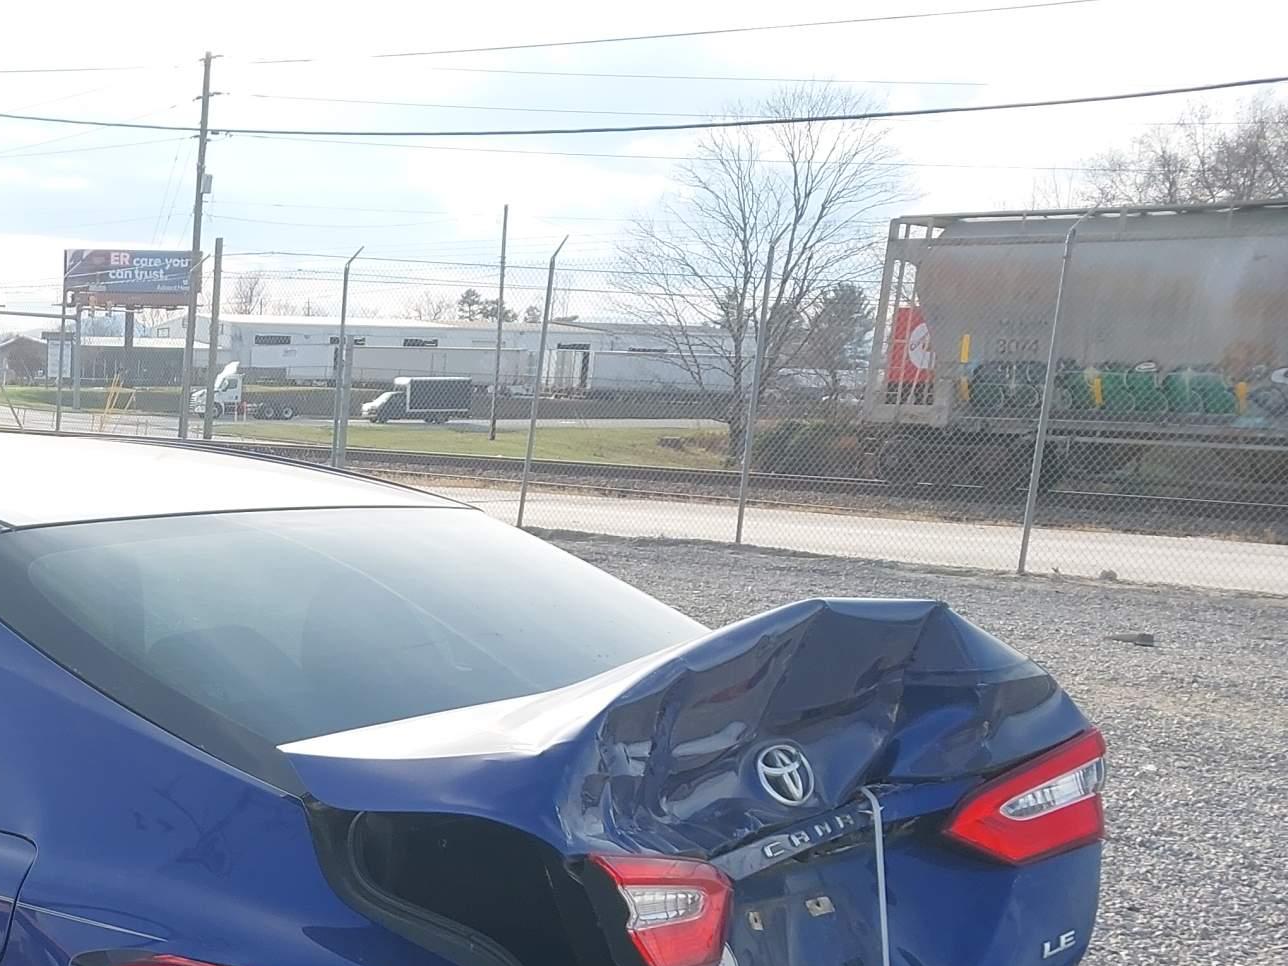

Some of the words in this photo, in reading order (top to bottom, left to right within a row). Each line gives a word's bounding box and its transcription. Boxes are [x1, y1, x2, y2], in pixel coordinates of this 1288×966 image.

[110, 252, 130, 266] ER
[133, 256, 163, 268] care
[165, 257, 189, 269] you
[108, 270, 133, 279] can
[1043, 930, 1076, 959] LE
